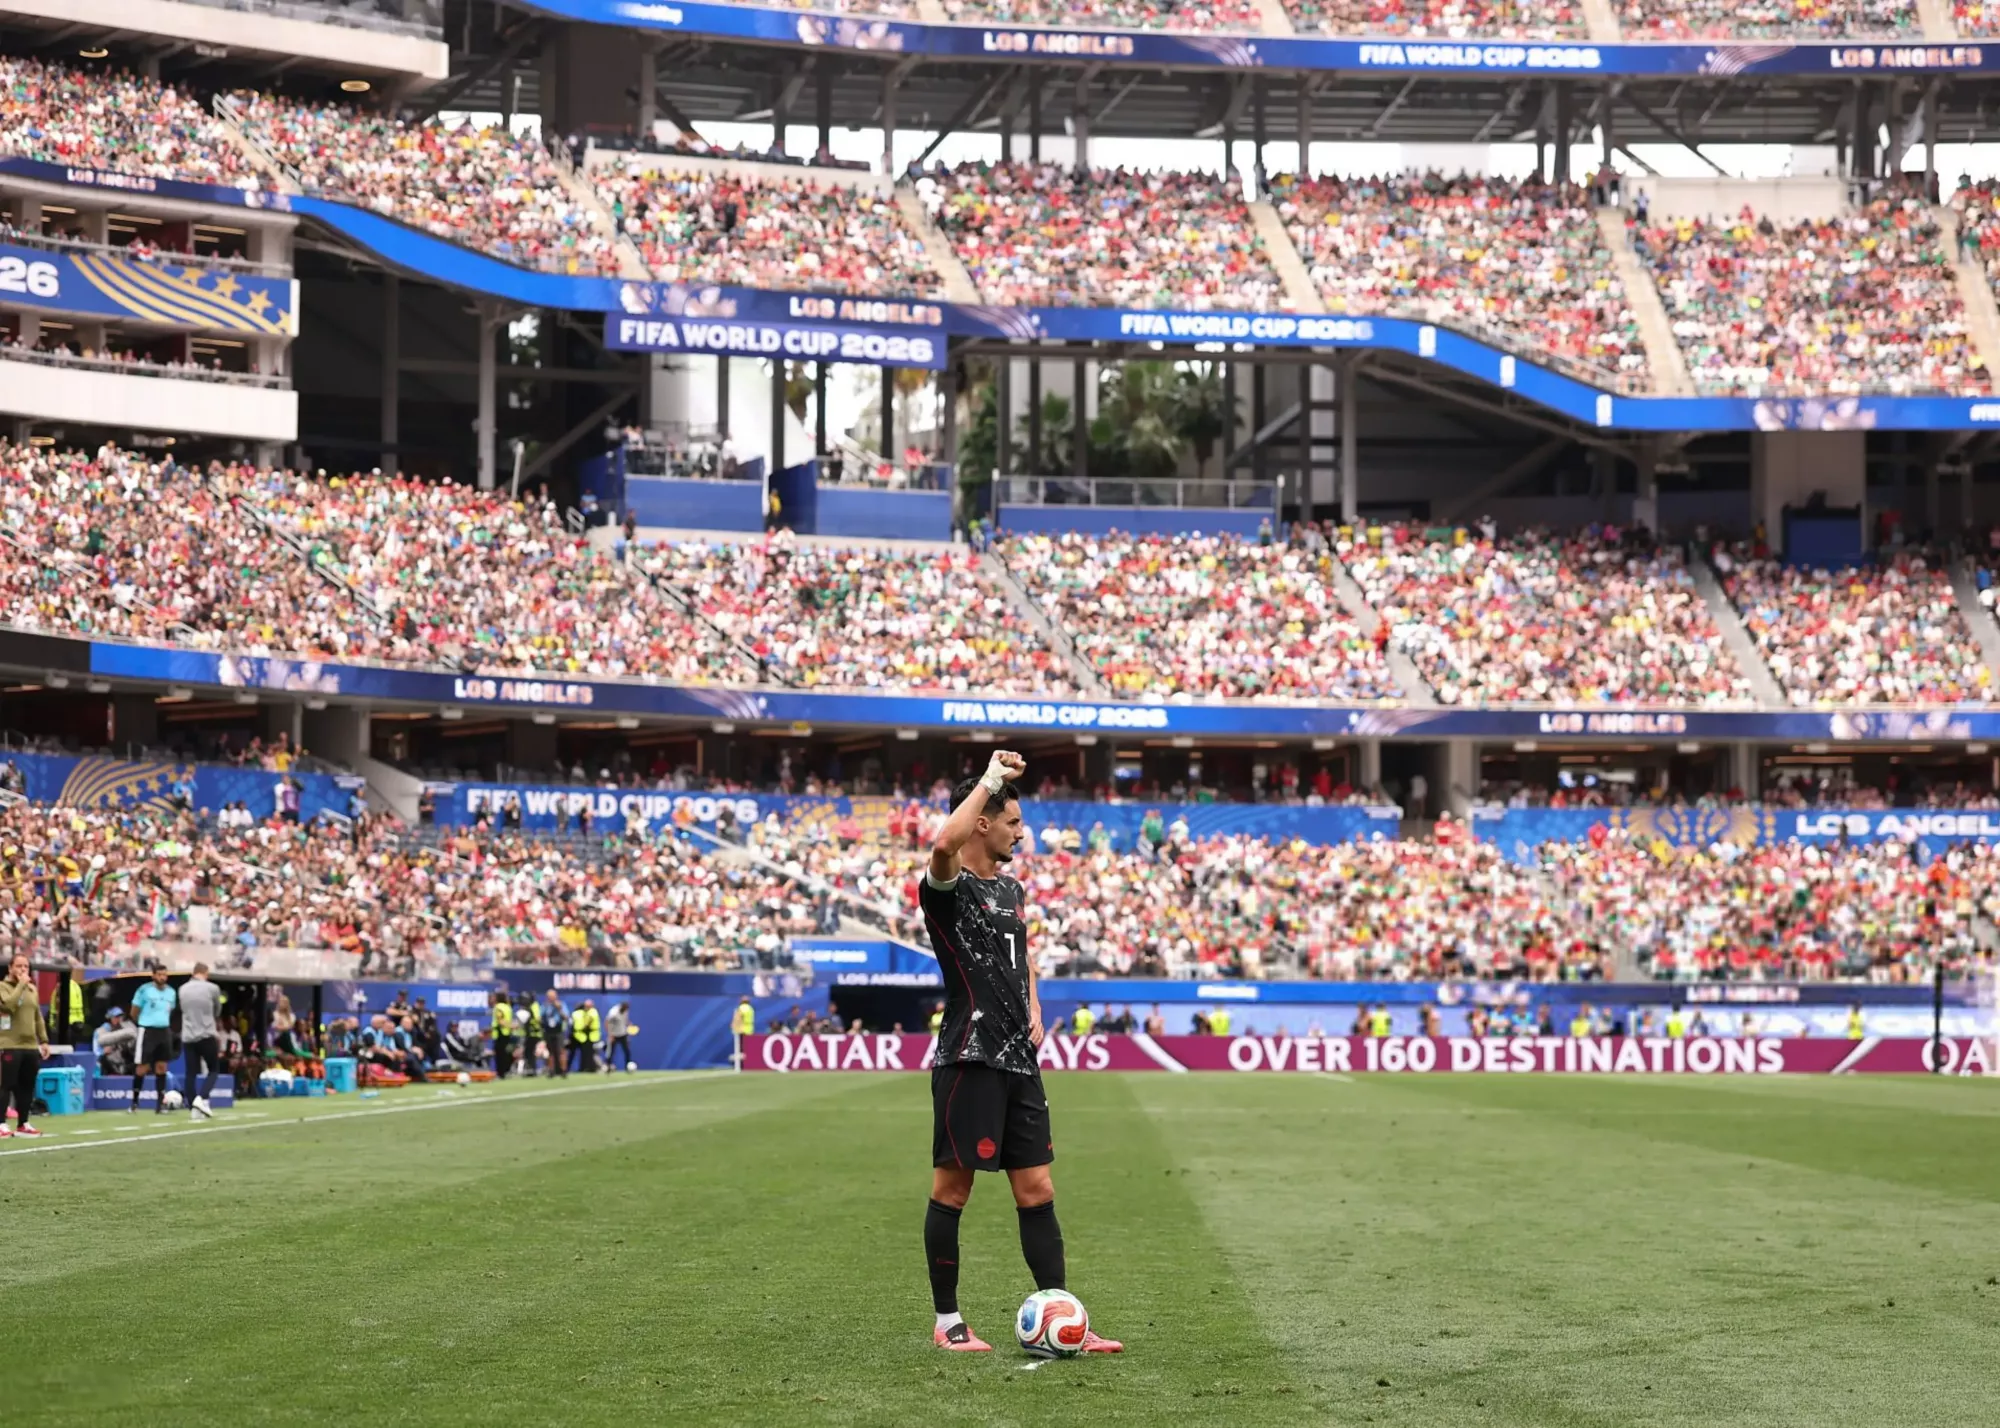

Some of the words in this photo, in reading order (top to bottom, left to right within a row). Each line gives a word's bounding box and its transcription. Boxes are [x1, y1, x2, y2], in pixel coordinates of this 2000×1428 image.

[983, 31, 1028, 52] LOS
[1358, 45, 1405, 65] FIFA
[1406, 46, 1481, 66] WORLD
[1483, 47, 1526, 67] CUP
[1830, 47, 1875, 68] LOS
[1879, 47, 1982, 67] ANGELES
[0, 255, 59, 297] 26
[790, 296, 835, 318] LOS
[839, 299, 943, 326] ANGELES
[1120, 314, 1169, 335] FIFA
[1170, 315, 1250, 337] WORLD
[1251, 317, 1297, 338] CUP
[620, 319, 679, 347] FIFA
[683, 323, 781, 352] WORLD
[783, 329, 839, 355] CUP
[841, 333, 934, 362] 2026
[454, 678, 496, 699] LOS
[500, 681, 593, 705] ANGELES
[942, 702, 986, 722] FIFA
[986, 703, 1057, 724] WORLD
[1058, 705, 1097, 726] CUP
[1539, 713, 1584, 733] LOS
[620, 793, 671, 820] CUP
[762, 1034, 904, 1073] QATAR
[1228, 1036, 1353, 1073] OVER
[1363, 1037, 1437, 1073] 160
[1449, 1037, 1785, 1074] DESTINATIONS
